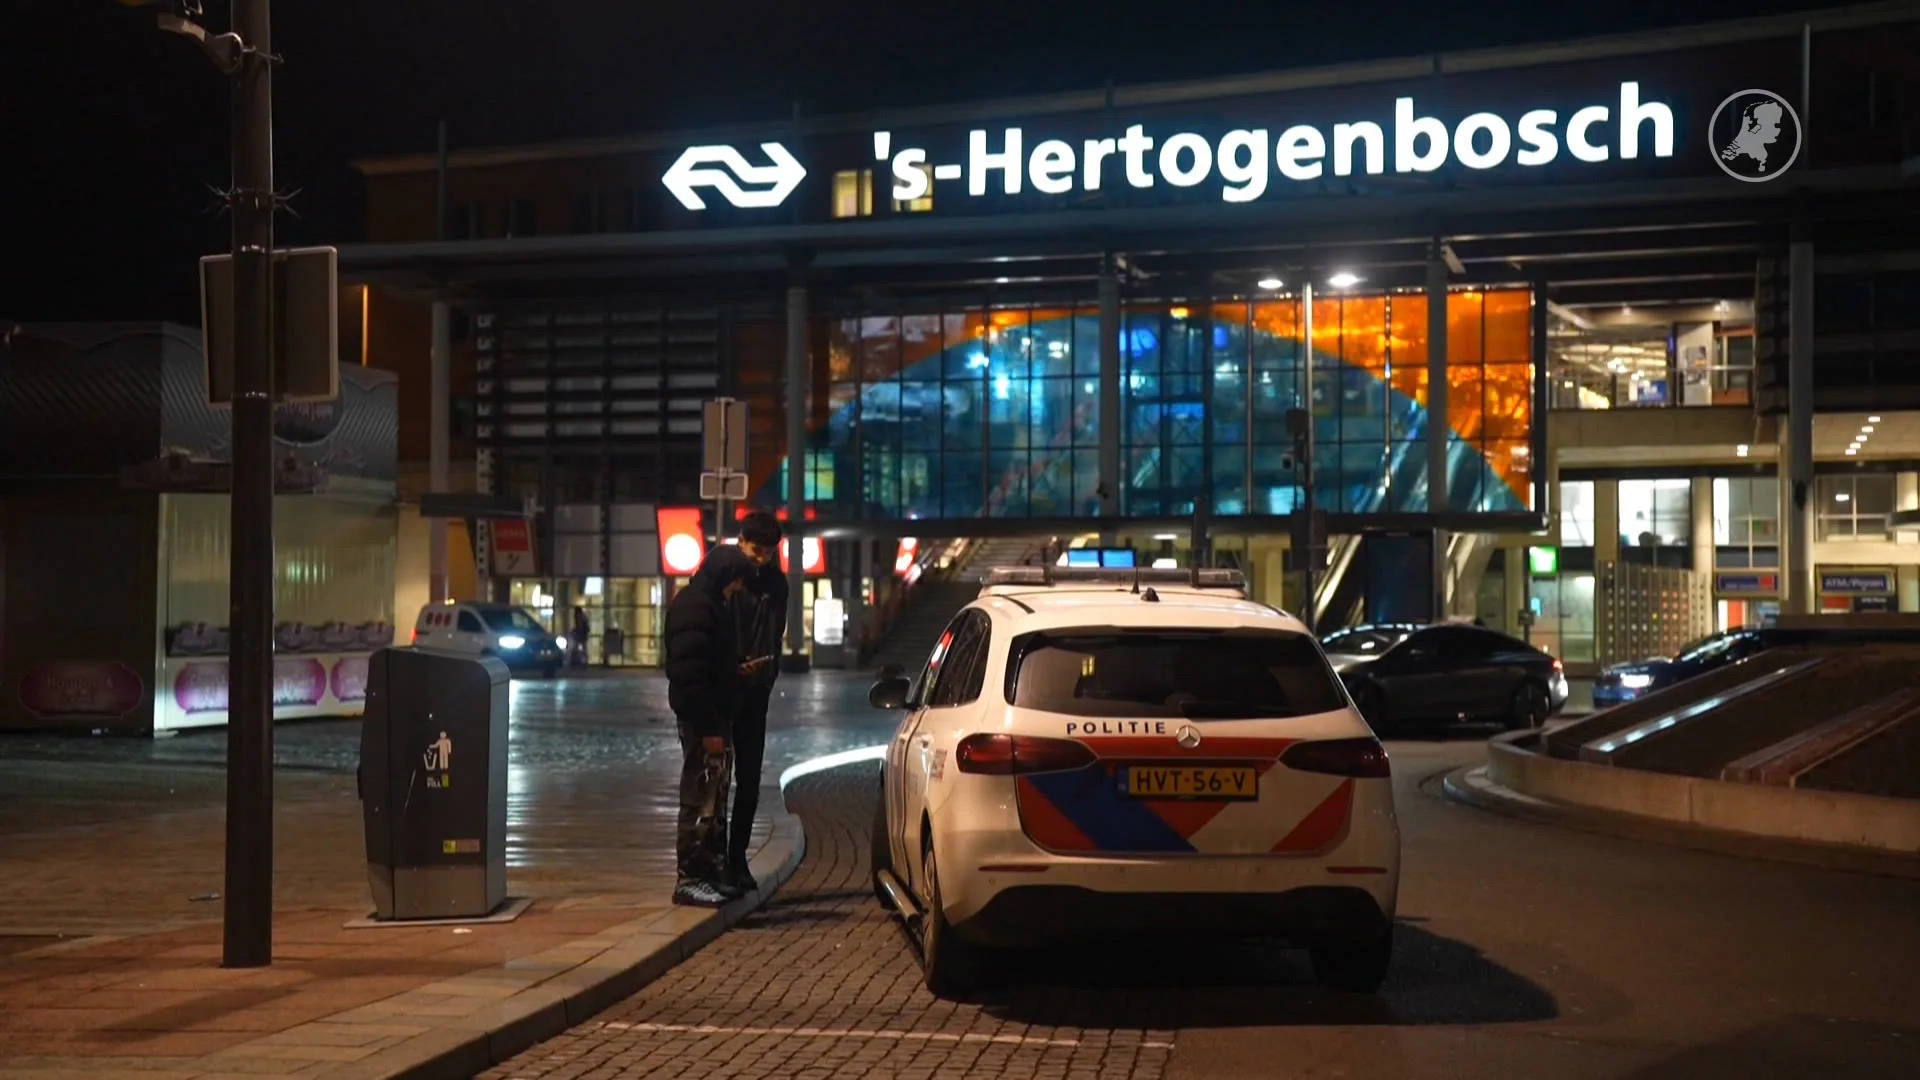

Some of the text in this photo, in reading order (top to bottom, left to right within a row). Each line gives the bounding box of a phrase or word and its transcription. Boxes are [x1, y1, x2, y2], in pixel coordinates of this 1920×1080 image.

[874, 82, 1674, 204] 's-Hertogenbosch
[1067, 721, 1166, 735] POLITIE
[1136, 769, 1247, 793] HVT-56-V
